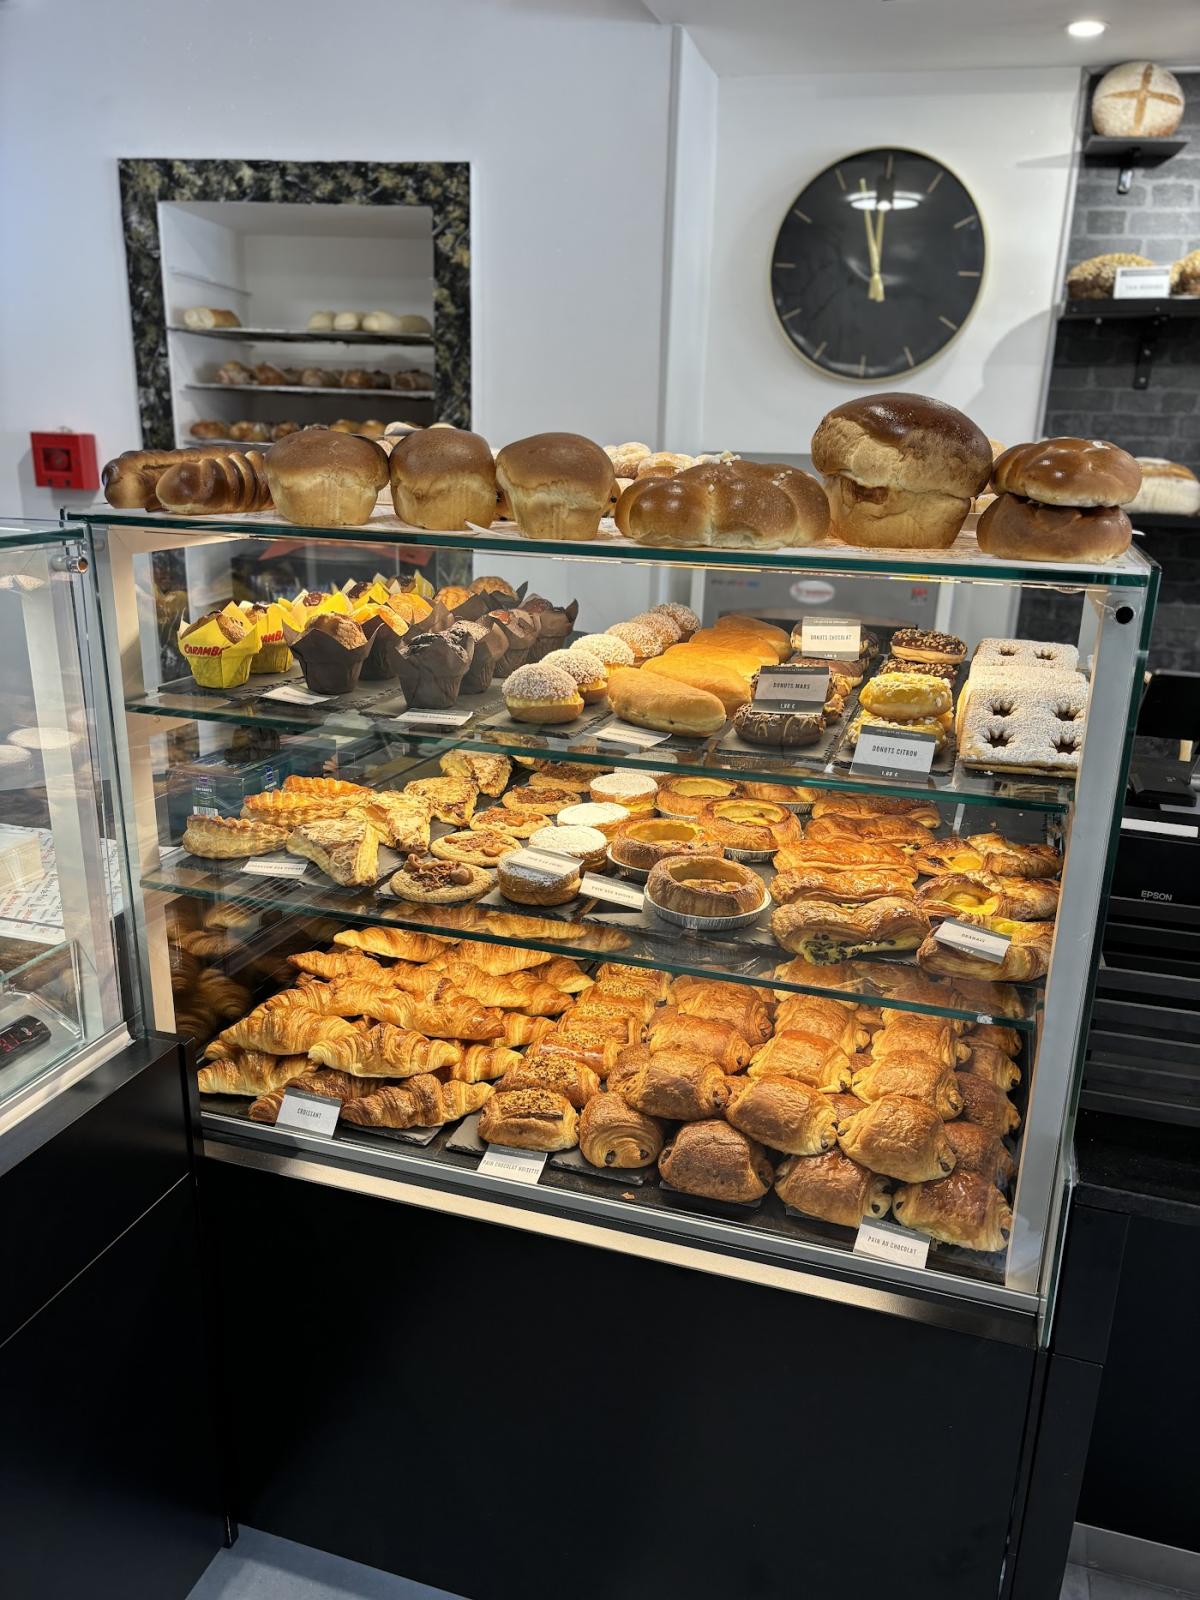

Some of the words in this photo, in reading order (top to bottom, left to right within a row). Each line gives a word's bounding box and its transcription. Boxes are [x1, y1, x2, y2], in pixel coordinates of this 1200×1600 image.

[871, 744, 895, 755] DONUTS
[895, 748, 918, 758] CITRON
[1140, 889, 1173, 901] EPSON
[296, 1107, 322, 1119] CROISSANT
[483, 1159, 494, 1168] PAIN
[494, 1161, 518, 1171] CHOCOLAT
[867, 1235, 880, 1244] PAIN
[889, 1243, 918, 1255] CHOCOLAT
